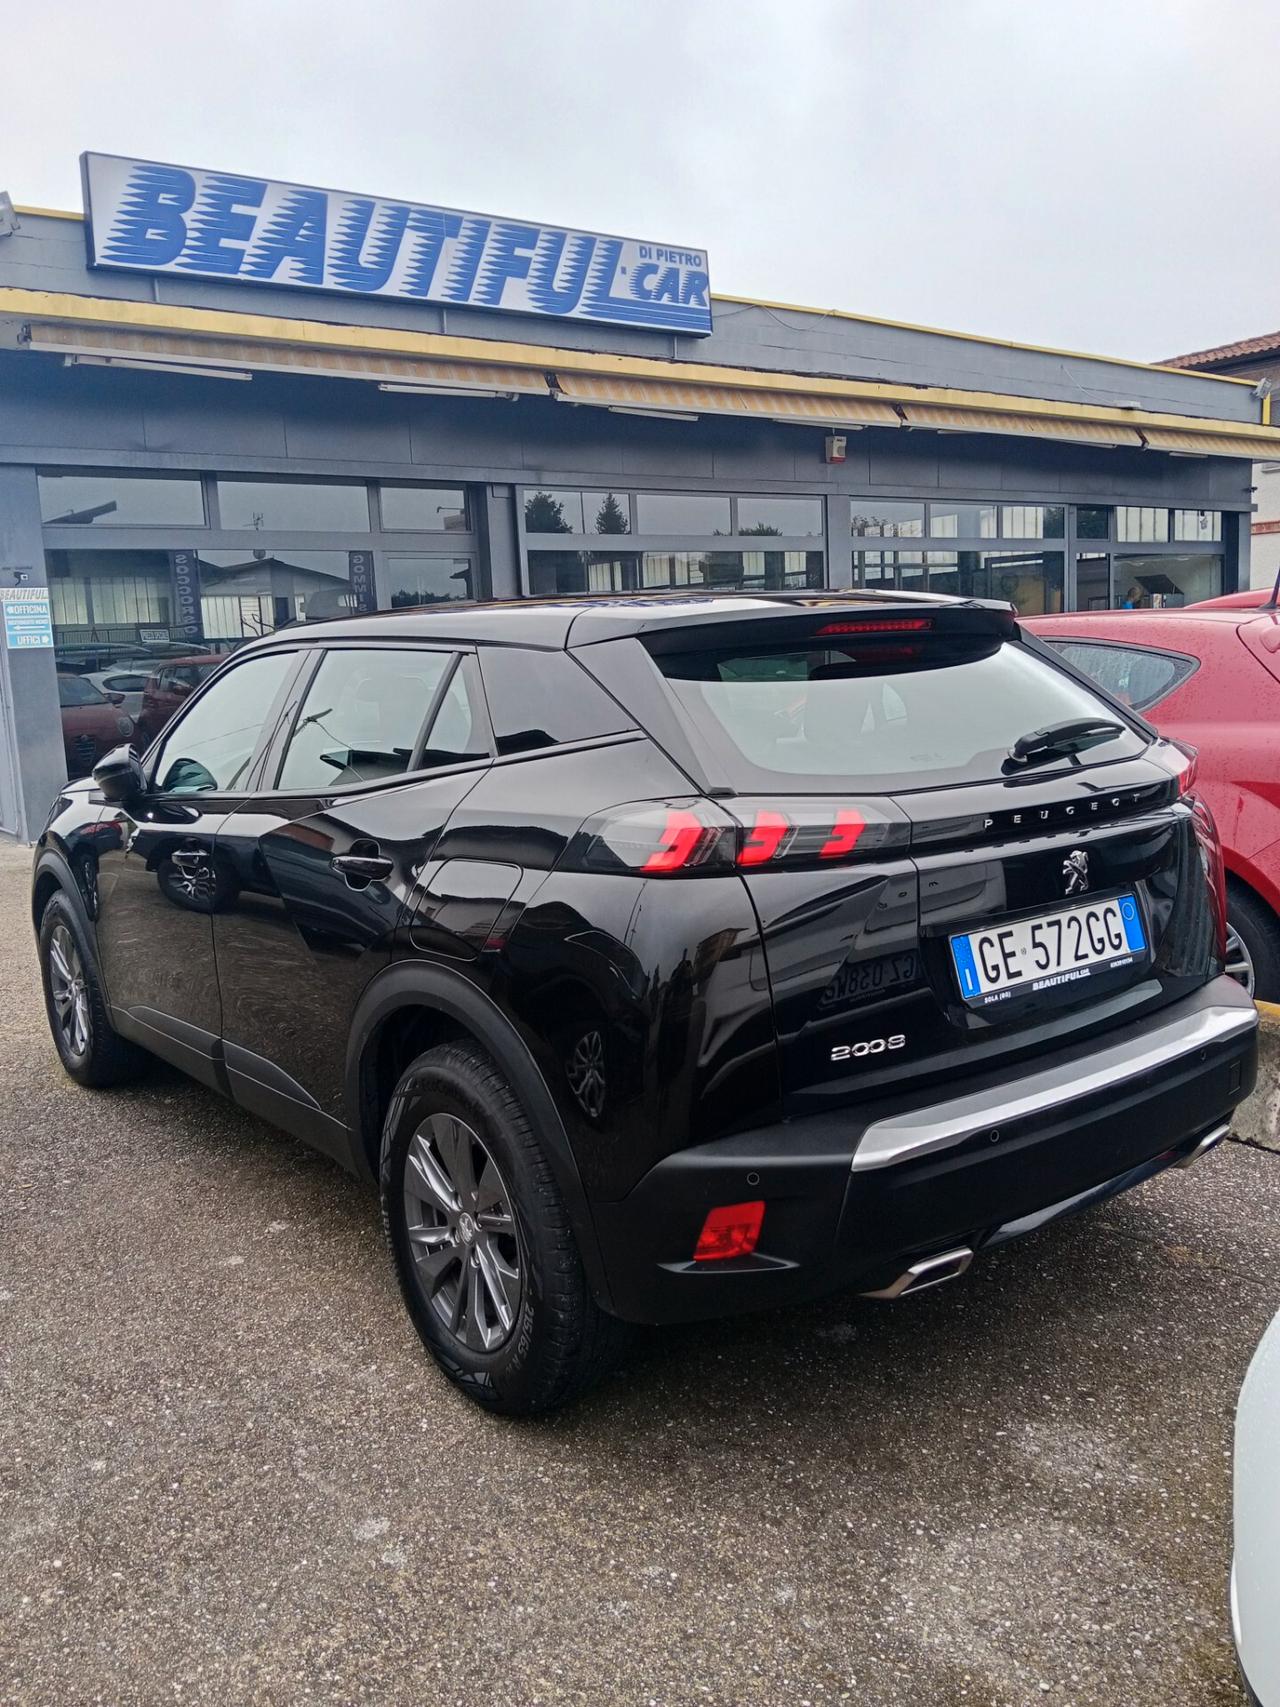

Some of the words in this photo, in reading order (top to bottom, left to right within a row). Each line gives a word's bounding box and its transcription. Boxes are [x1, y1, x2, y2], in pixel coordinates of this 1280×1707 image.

[99, 165, 710, 332] BEAUTIFUL
[639, 246, 652, 260] DI
[656, 248, 702, 267] PIETRO
[629, 263, 709, 306] CAR
[15, 604, 48, 614] OFFICINA
[984, 793, 1141, 829] PEUGEOT
[978, 930, 1023, 984] GE
[1031, 907, 1123, 970] 572GG
[830, 1034, 906, 1061] 2008
